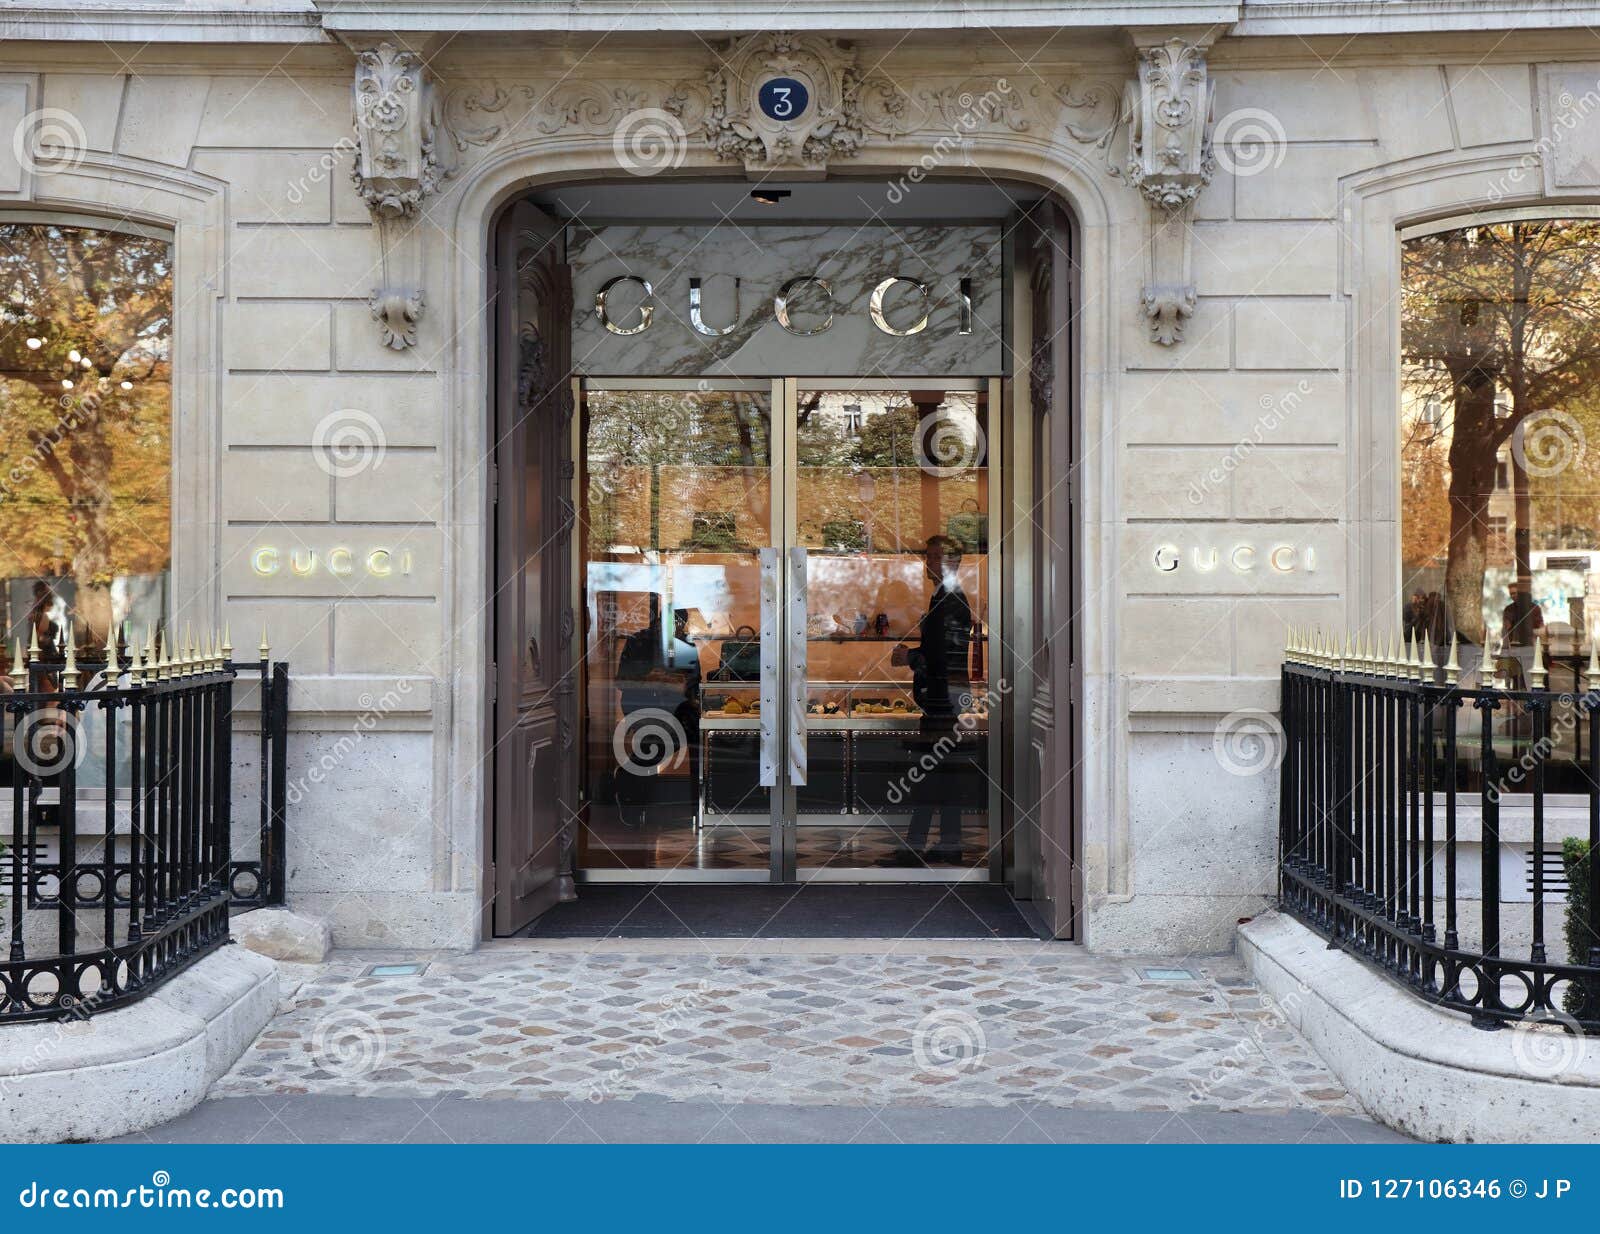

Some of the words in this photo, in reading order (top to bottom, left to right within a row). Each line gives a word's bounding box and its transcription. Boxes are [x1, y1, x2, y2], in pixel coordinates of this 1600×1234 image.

[773, 87, 793, 117] 3
[595, 275, 973, 336] GUCCI
[252, 547, 411, 576] GUCCI
[1154, 545, 1315, 573] GUCCI
